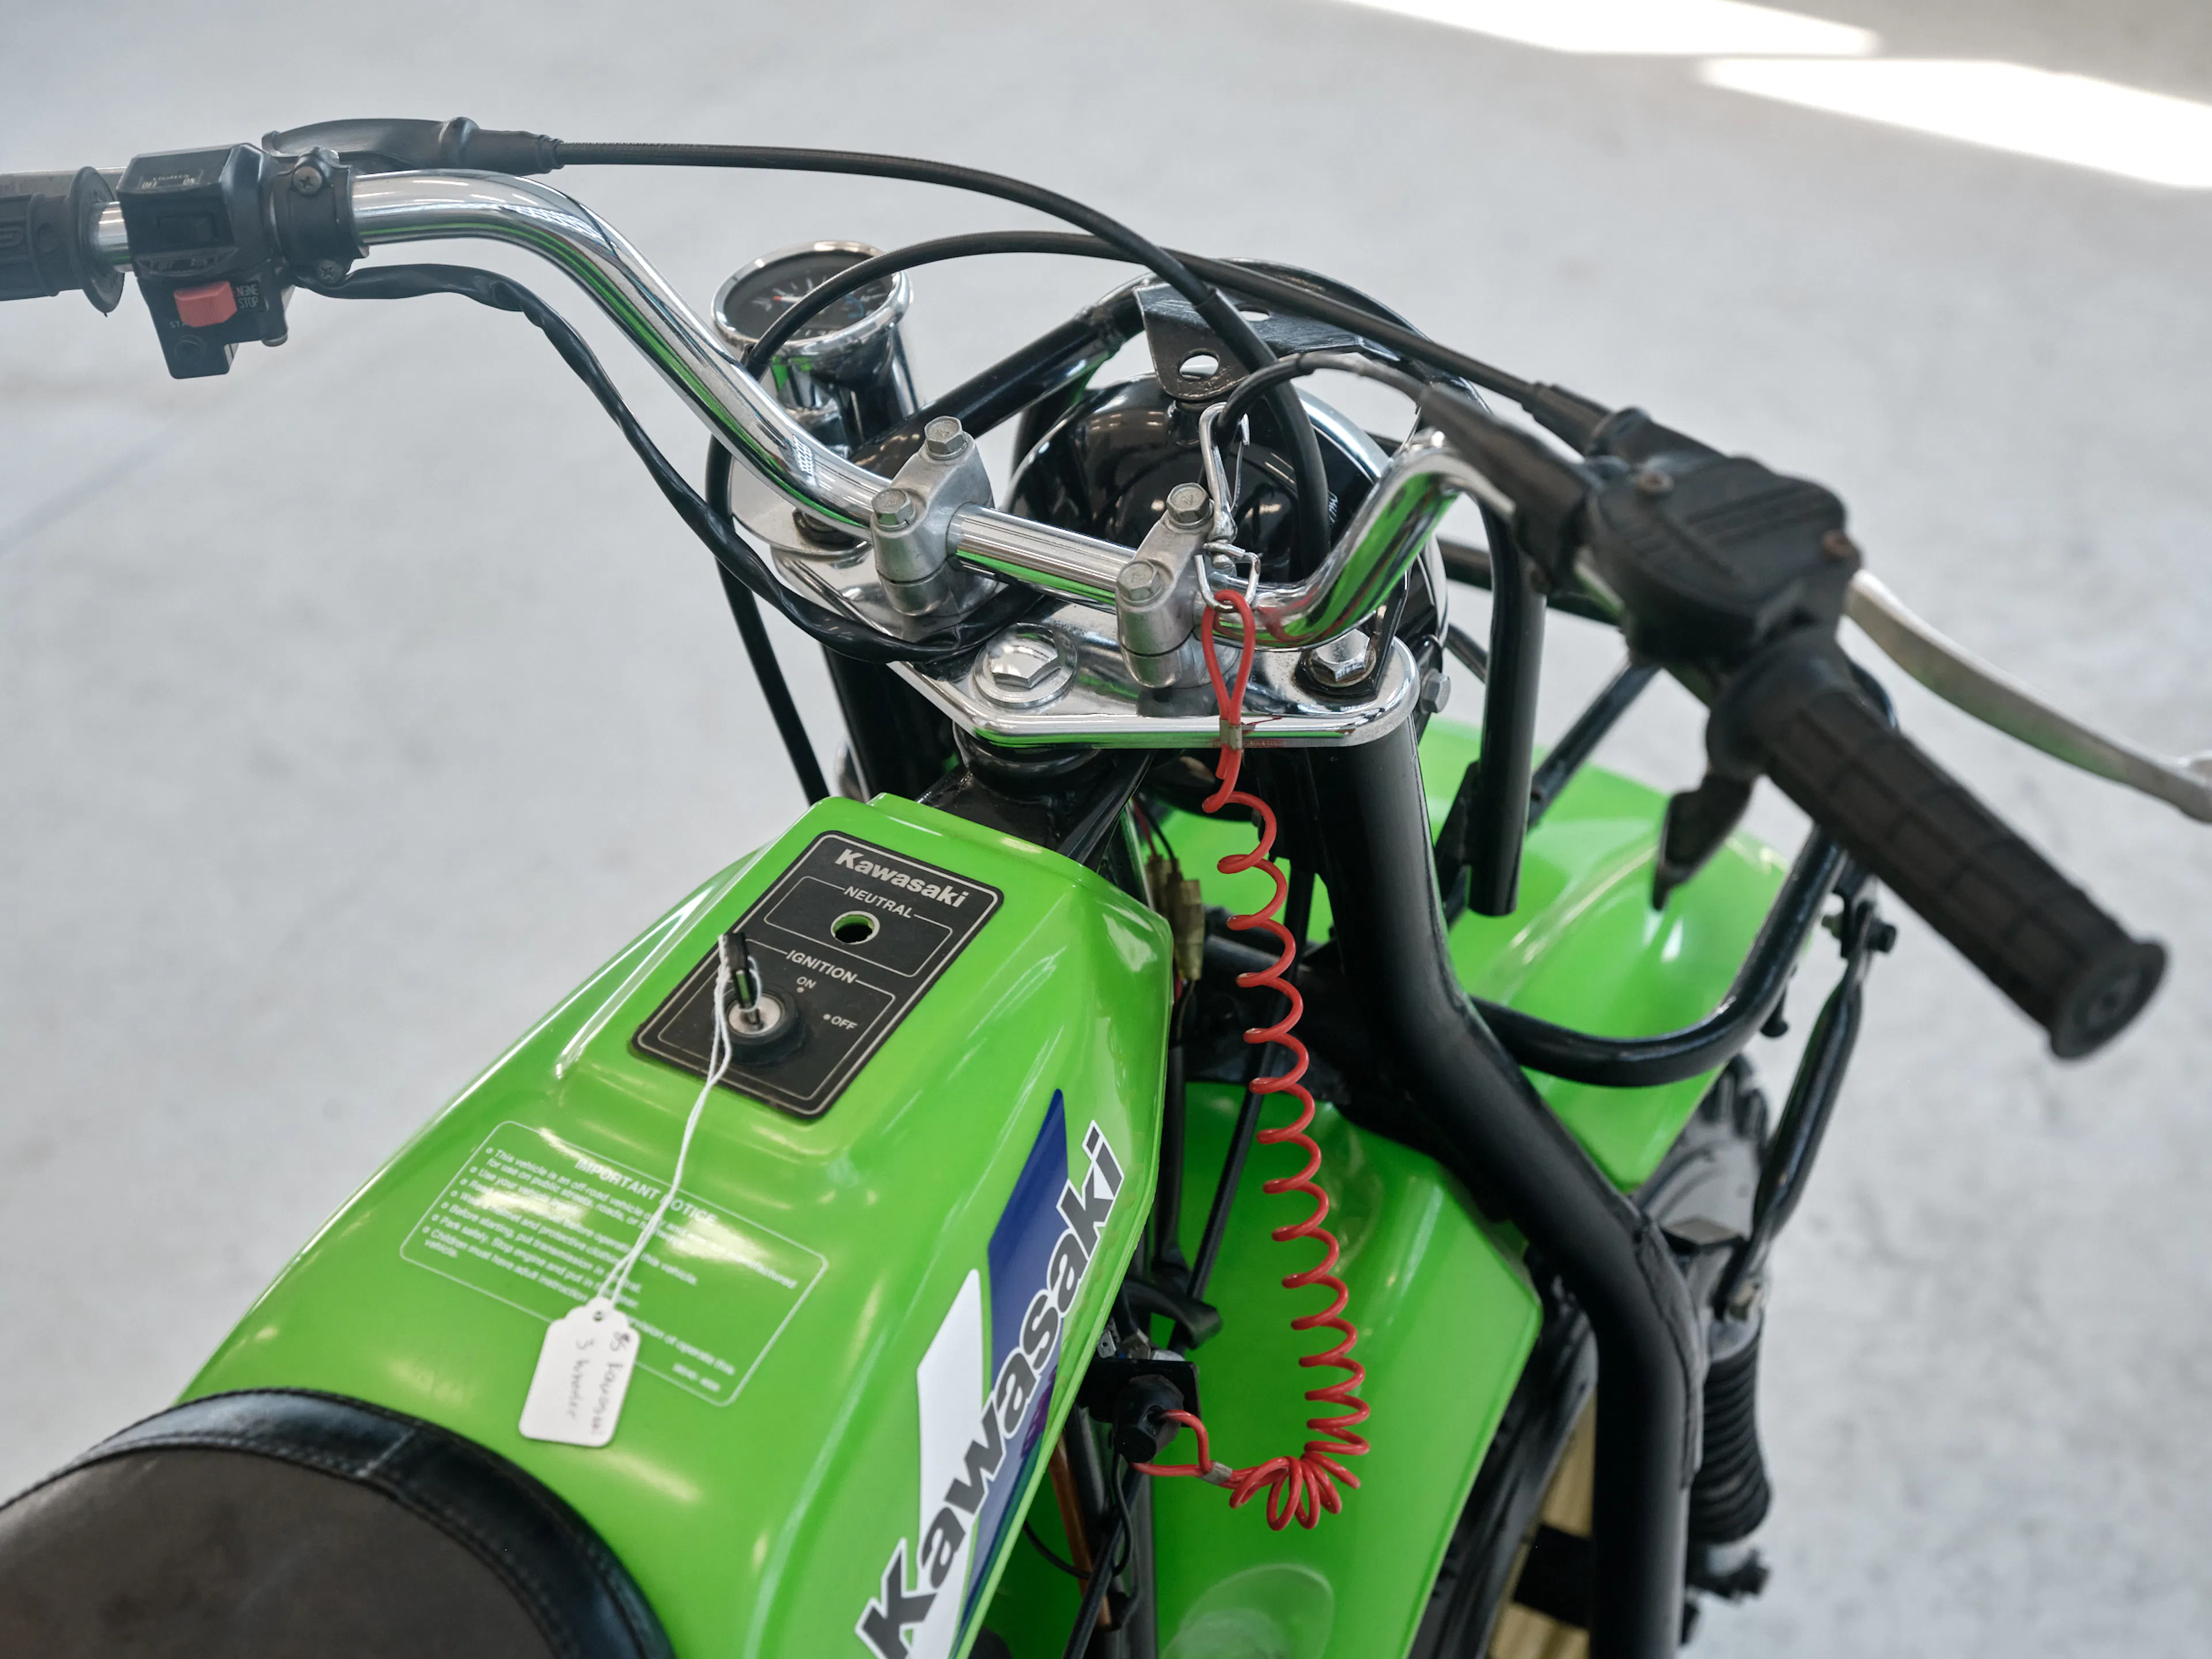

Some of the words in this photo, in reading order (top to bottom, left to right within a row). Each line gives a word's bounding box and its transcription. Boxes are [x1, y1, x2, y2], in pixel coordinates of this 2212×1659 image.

[237, 297, 259, 309] STOP
[835, 848, 969, 908] Kawasaki
[843, 885, 912, 918] NEUTRAL
[786, 949, 858, 983] IGNITION
[796, 976, 817, 989] ON
[831, 1016, 858, 1030] OFF
[574, 1159, 658, 1198] IMPORTANT
[856, 1121, 1124, 1659] Kawasaki
